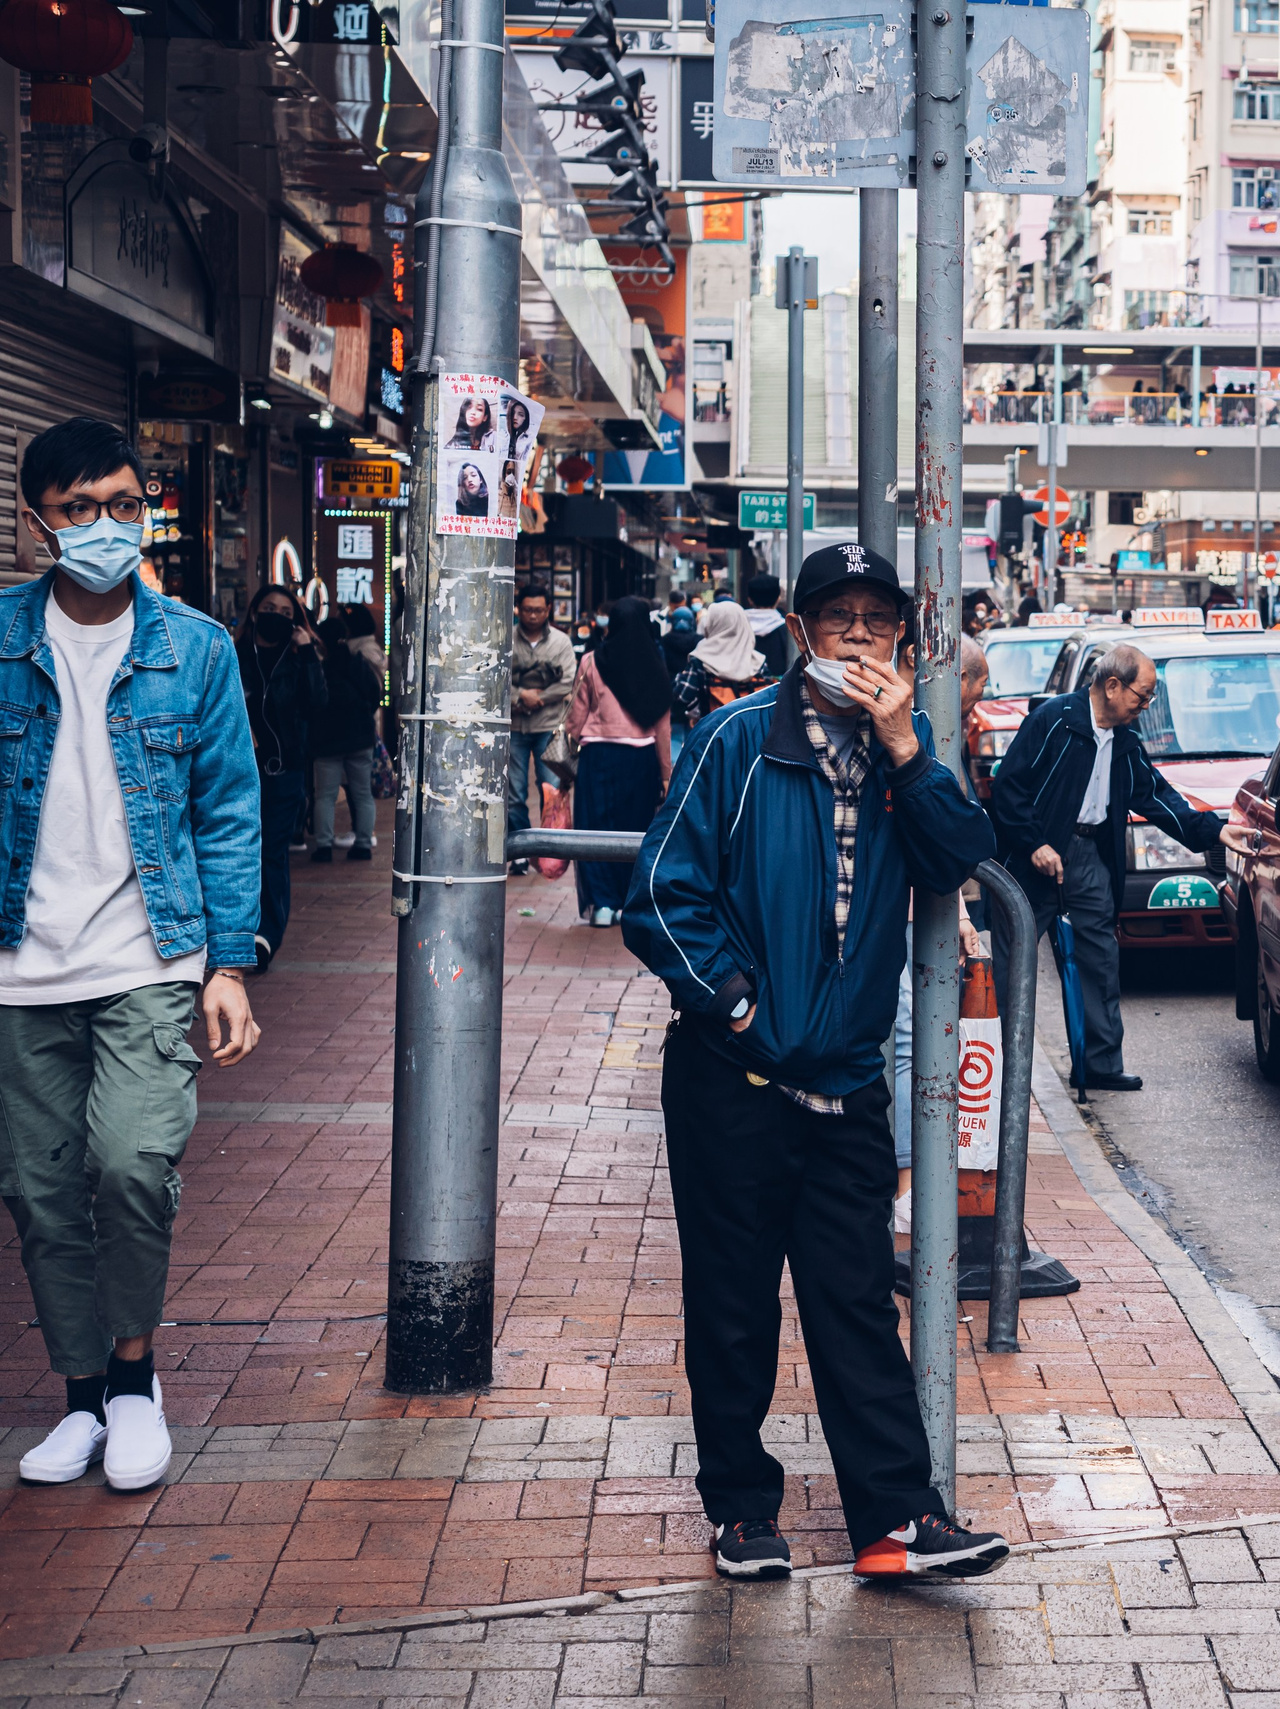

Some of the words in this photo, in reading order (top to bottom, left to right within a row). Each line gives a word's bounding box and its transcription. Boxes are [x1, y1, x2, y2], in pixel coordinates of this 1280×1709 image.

[333, 466, 382, 474] WESTERN
[349, 474, 382, 482] UNION
[744, 495, 768, 506] TAXI
[772, 497, 811, 508] STD
[755, 510, 788, 524] 的士
[336, 524, 374, 604] 匯款
[848, 554, 862, 563] THE
[1034, 614, 1080, 625] TAXI
[1141, 611, 1175, 622] TAXI
[1212, 614, 1257, 628] TAXI
[1177, 883, 1192, 898] 5
